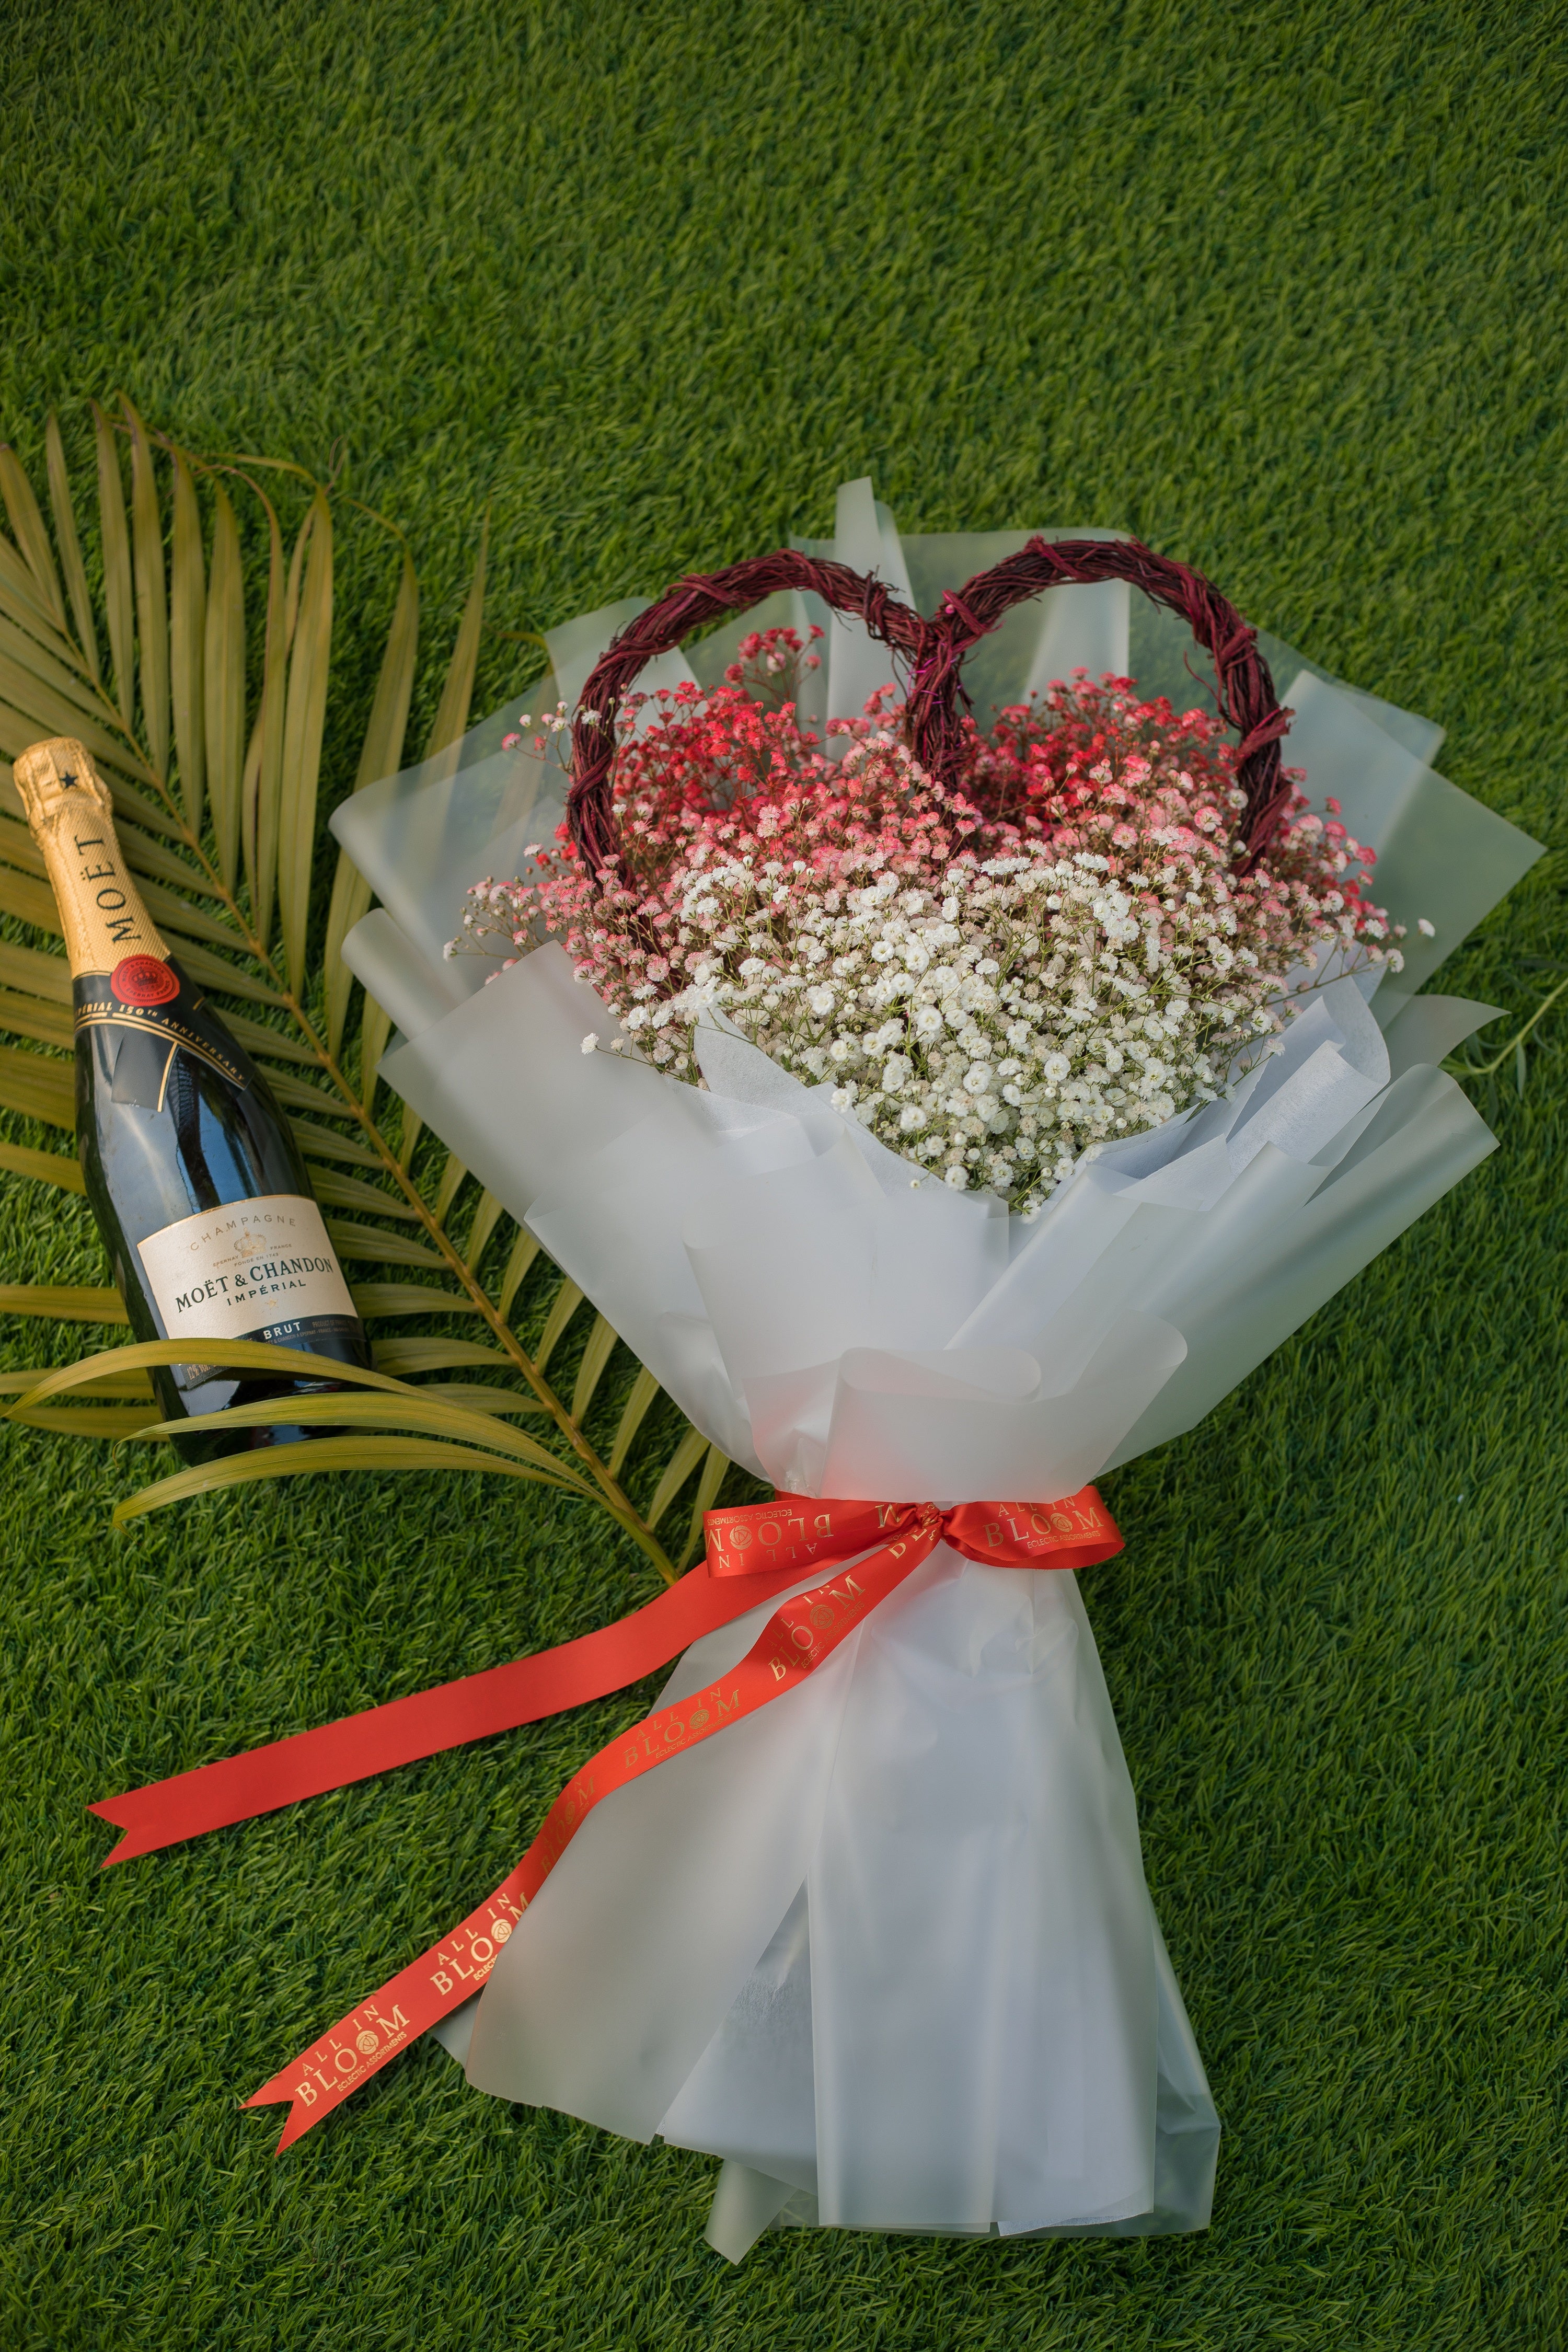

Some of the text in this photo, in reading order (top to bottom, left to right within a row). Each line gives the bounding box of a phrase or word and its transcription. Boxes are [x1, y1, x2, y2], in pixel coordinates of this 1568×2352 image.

[74, 835, 141, 943] MOËT
[161, 1017, 245, 1081] ANNIVERSARY
[190, 1214, 296, 1251] CHAMPAGNE
[175, 1257, 333, 1313] MOËT & CHANDON
[226, 1279, 306, 1306] IMPÉRIAL
[263, 1322, 300, 1340] BRUT
[704, 1514, 834, 1553] BLOOM
[707, 1509, 793, 1526] ECLECTIC ASSORTMENTS
[983, 1507, 1104, 1547] BLOOM
[998, 1502, 1037, 1517] ALL
[718, 1543, 818, 1569] ALL IN
[1027, 1530, 1101, 1549] ECLECTIC ASSORTMENTS
[767, 1617, 794, 1651] ALL
[768, 1574, 866, 1682] BLOOM
[801, 1601, 865, 1669] ECLECTIC ASSORTMENTS
[622, 1689, 741, 1769] BLOOM
[636, 1687, 721, 1742] ALL IN
[655, 1714, 732, 1759] ECLECTIC ASSORTMENTS
[430, 1892, 529, 1996] BLOOM
[437, 1893, 511, 1966] ALL IN
[294, 2004, 410, 2107] BLOOM
[302, 2004, 379, 2077] ALL IN
[337, 2031, 408, 2092] ECLECTIC ASSORTMENTS
